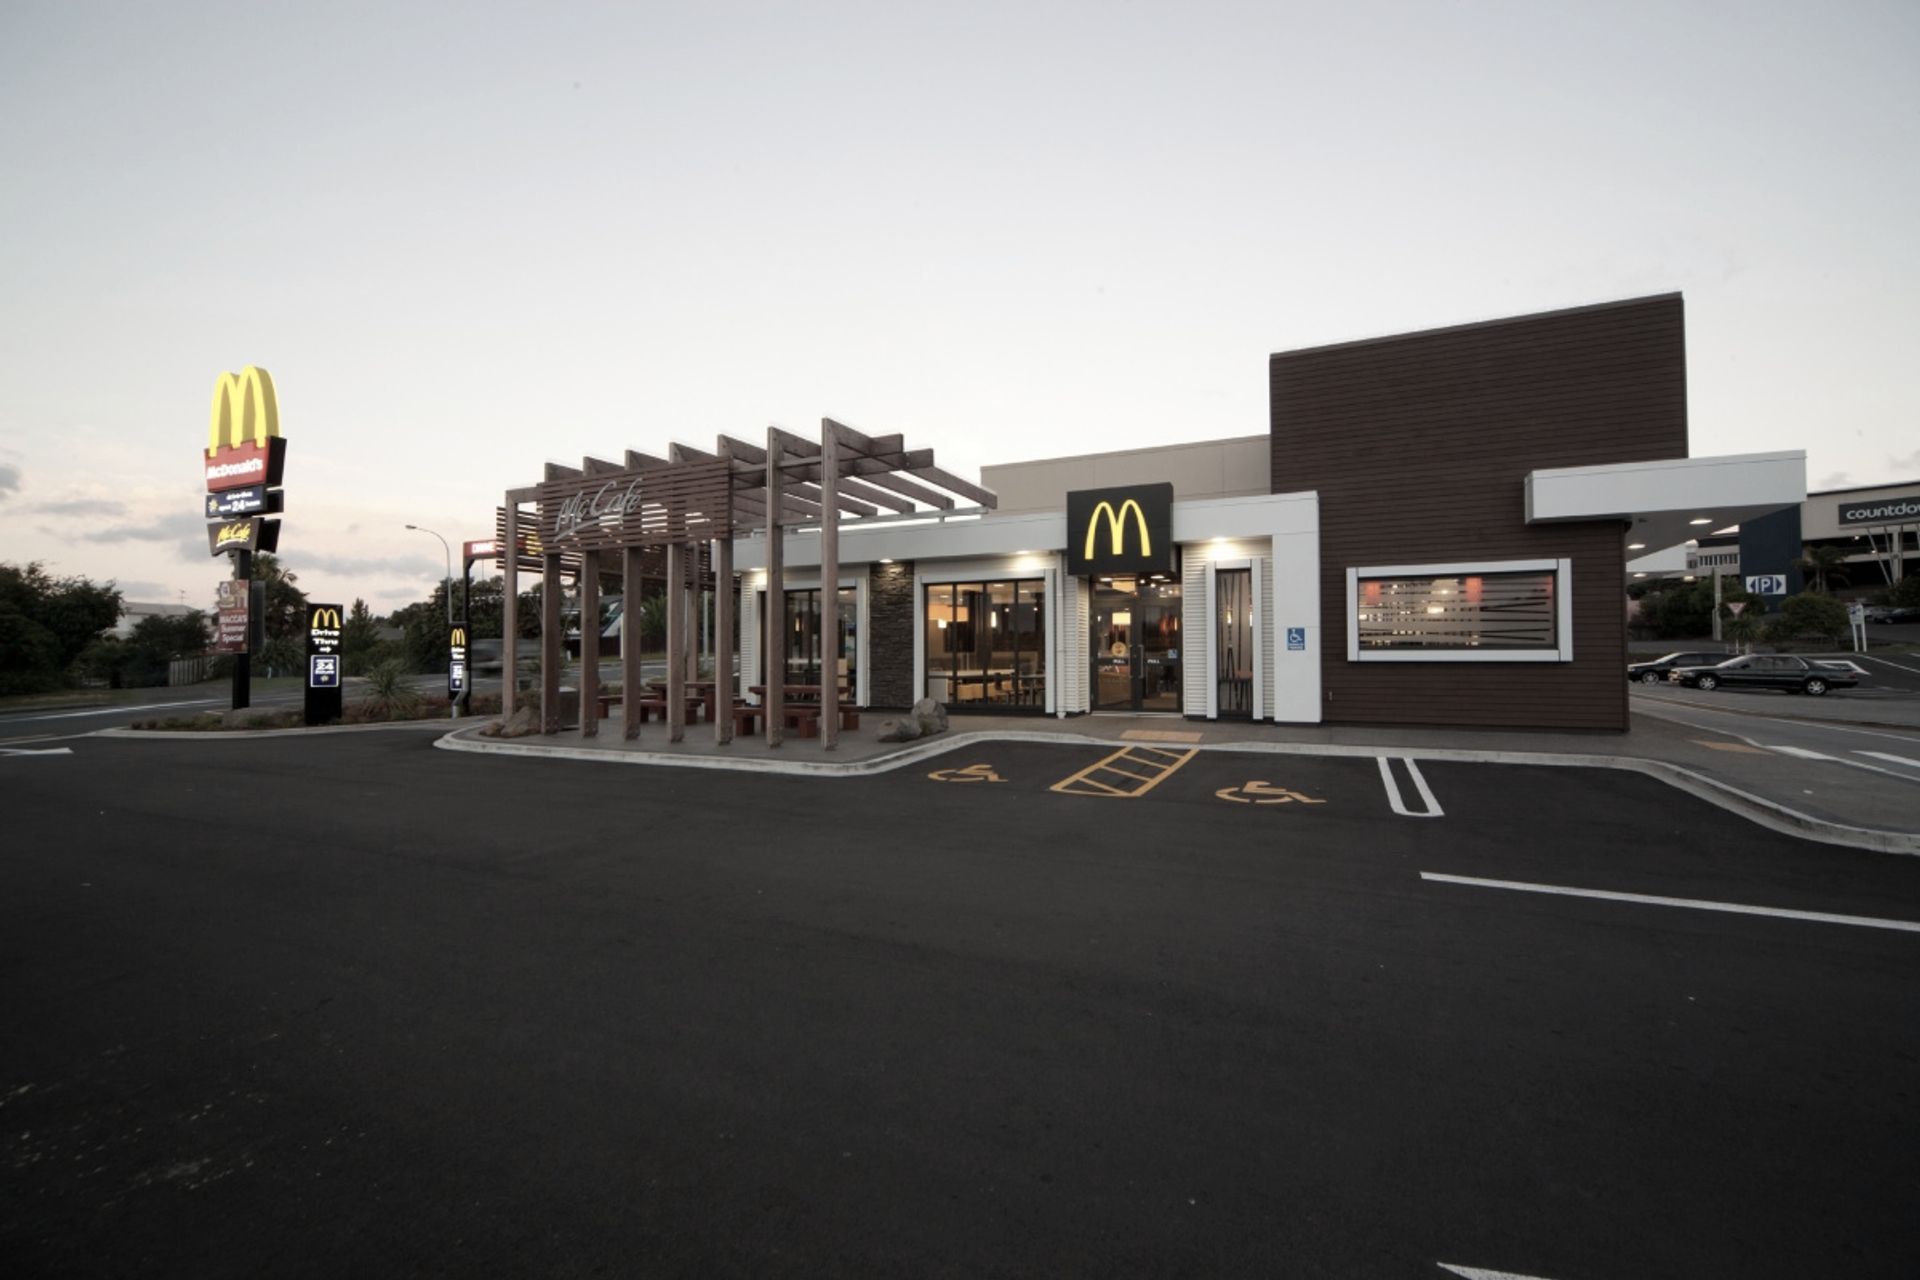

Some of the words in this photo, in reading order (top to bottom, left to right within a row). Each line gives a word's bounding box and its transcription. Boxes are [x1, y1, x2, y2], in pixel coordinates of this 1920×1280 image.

[206, 458, 263, 480] McDonald's
[231, 500, 246, 512] 24
[1846, 502, 1920, 520] countdo
[311, 629, 340, 637] Drive
[312, 637, 339, 646] Thru
